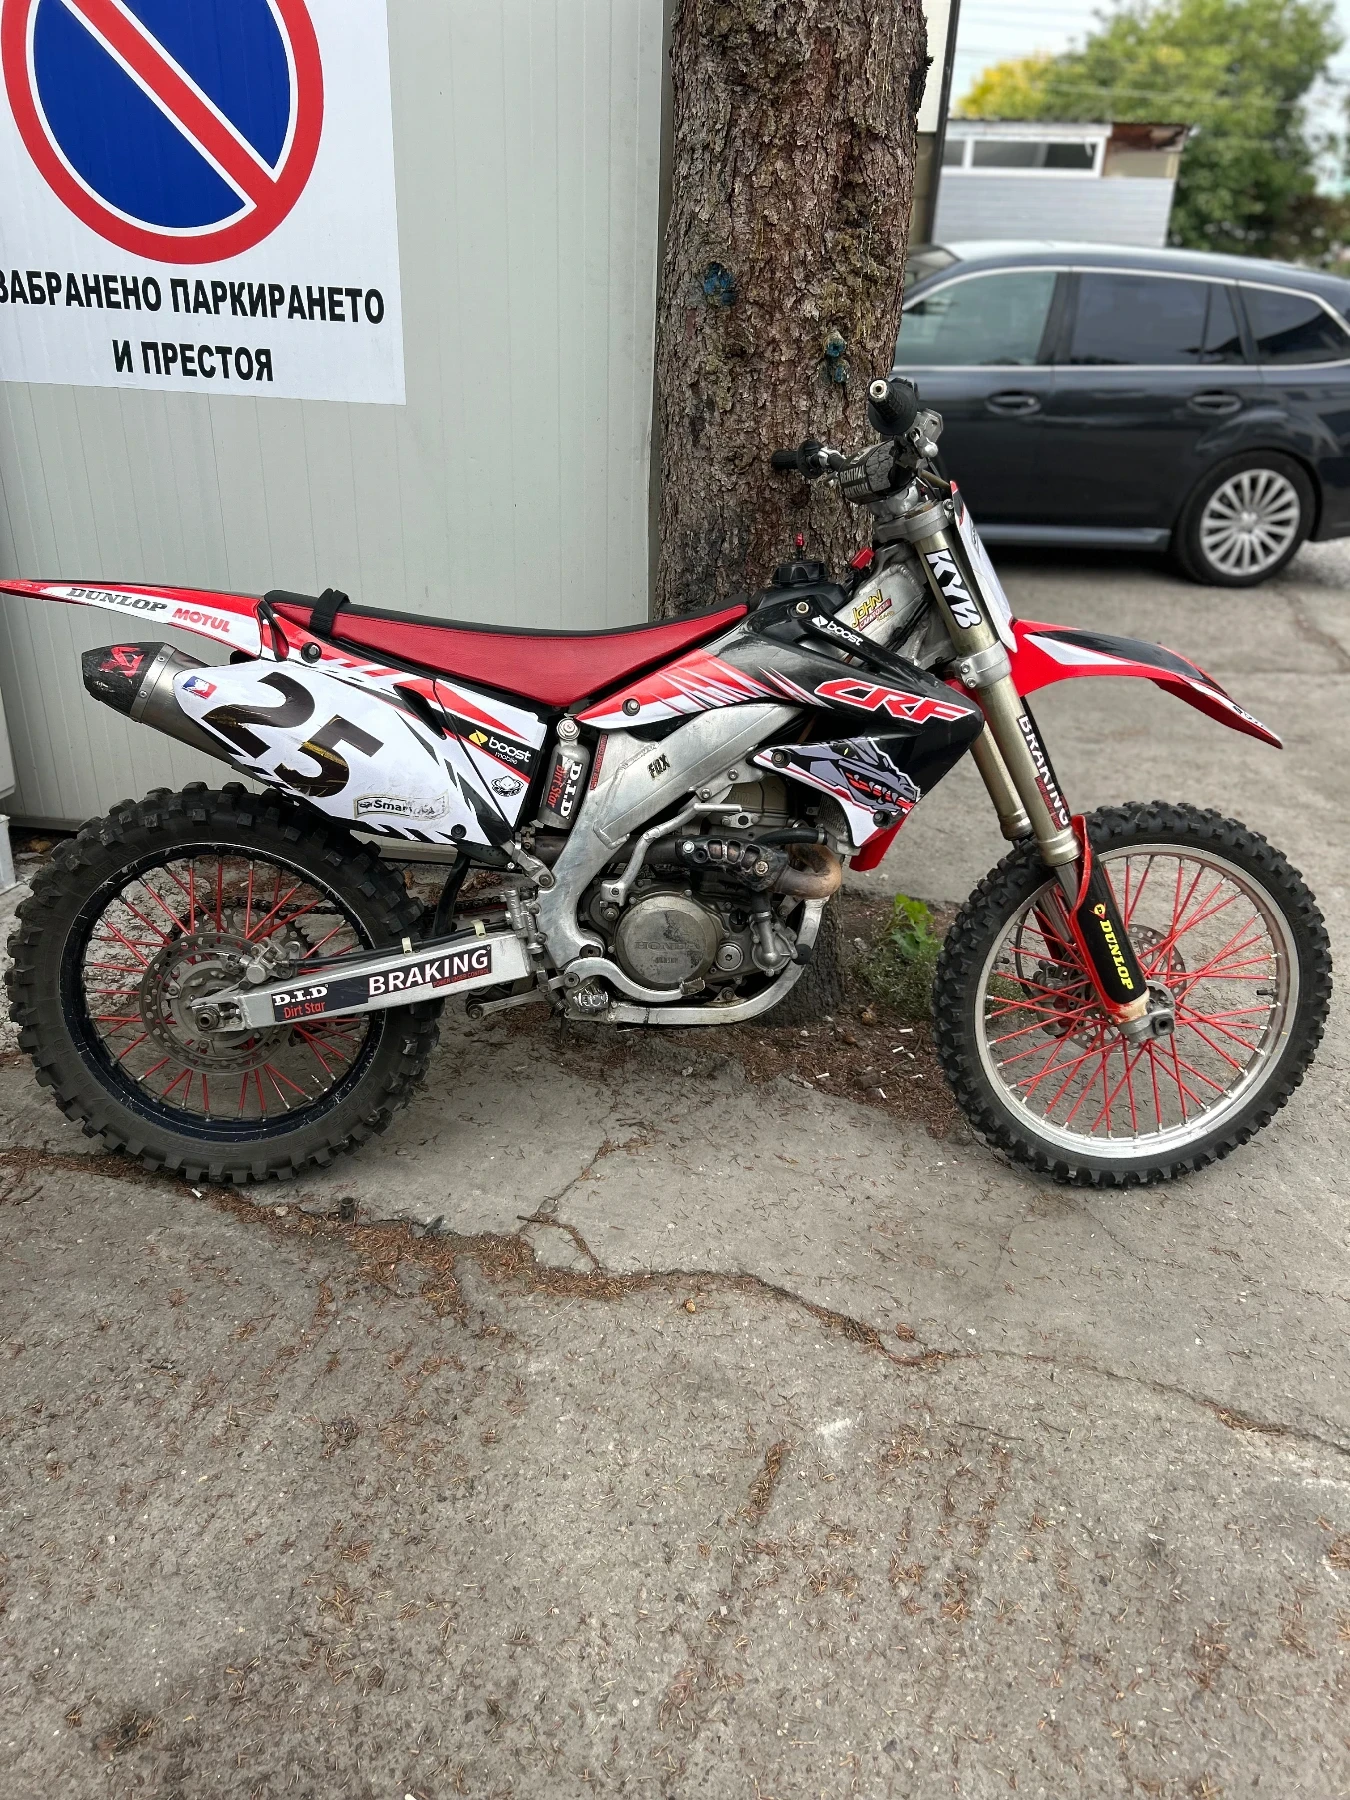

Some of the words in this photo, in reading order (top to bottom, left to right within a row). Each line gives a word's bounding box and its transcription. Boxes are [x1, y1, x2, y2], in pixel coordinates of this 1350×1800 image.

[170, 277, 385, 325] ПАРКИРАНЕТО
[112, 339, 133, 373] И
[141, 341, 274, 382] ПРЕСТОЯ
[66, 588, 168, 612] DUNLOP
[926, 549, 982, 627] KYB
[172, 607, 230, 632] MOTUL
[852, 589, 883, 628] JOHN
[827, 621, 863, 646] boost
[814, 678, 974, 723] CRF
[201, 672, 384, 797] 25
[489, 736, 531, 762] boost
[553, 765, 566, 787] Dirt
[561, 763, 583, 817] D.I.D
[1019, 716, 1069, 826] BRAKING
[548, 786, 562, 808] Star
[635, 941, 699, 950] HONDA
[1100, 920, 1134, 990] DUNLOP
[369, 950, 489, 995] BRAKING
[273, 986, 328, 1005] D.I.D
[284, 1004, 303, 1018] Dirt
[304, 1001, 326, 1014] Star
